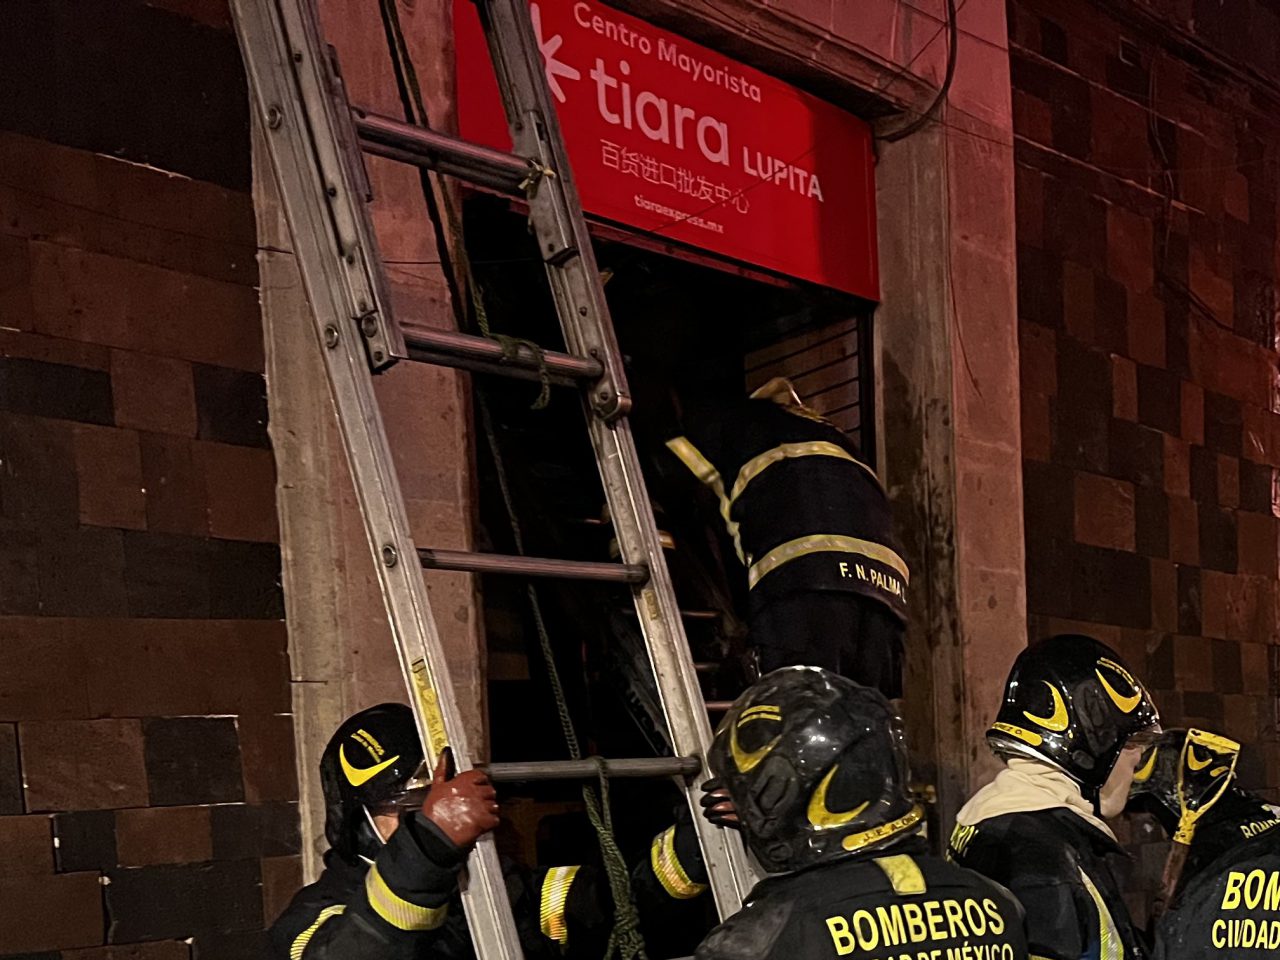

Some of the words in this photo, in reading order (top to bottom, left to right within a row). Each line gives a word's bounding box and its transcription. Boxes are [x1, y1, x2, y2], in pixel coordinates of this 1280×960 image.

[573, 2, 650, 54] Centro
[657, 38, 761, 103] Mayorista
[589, 57, 730, 168] tiara
[743, 146, 824, 202] LUPITA
[600, 139, 749, 214] 百货进口批发中心
[839, 562, 853, 578] F.
[855, 563, 869, 581] N.
[826, 898, 1005, 956] BOMBEROS
